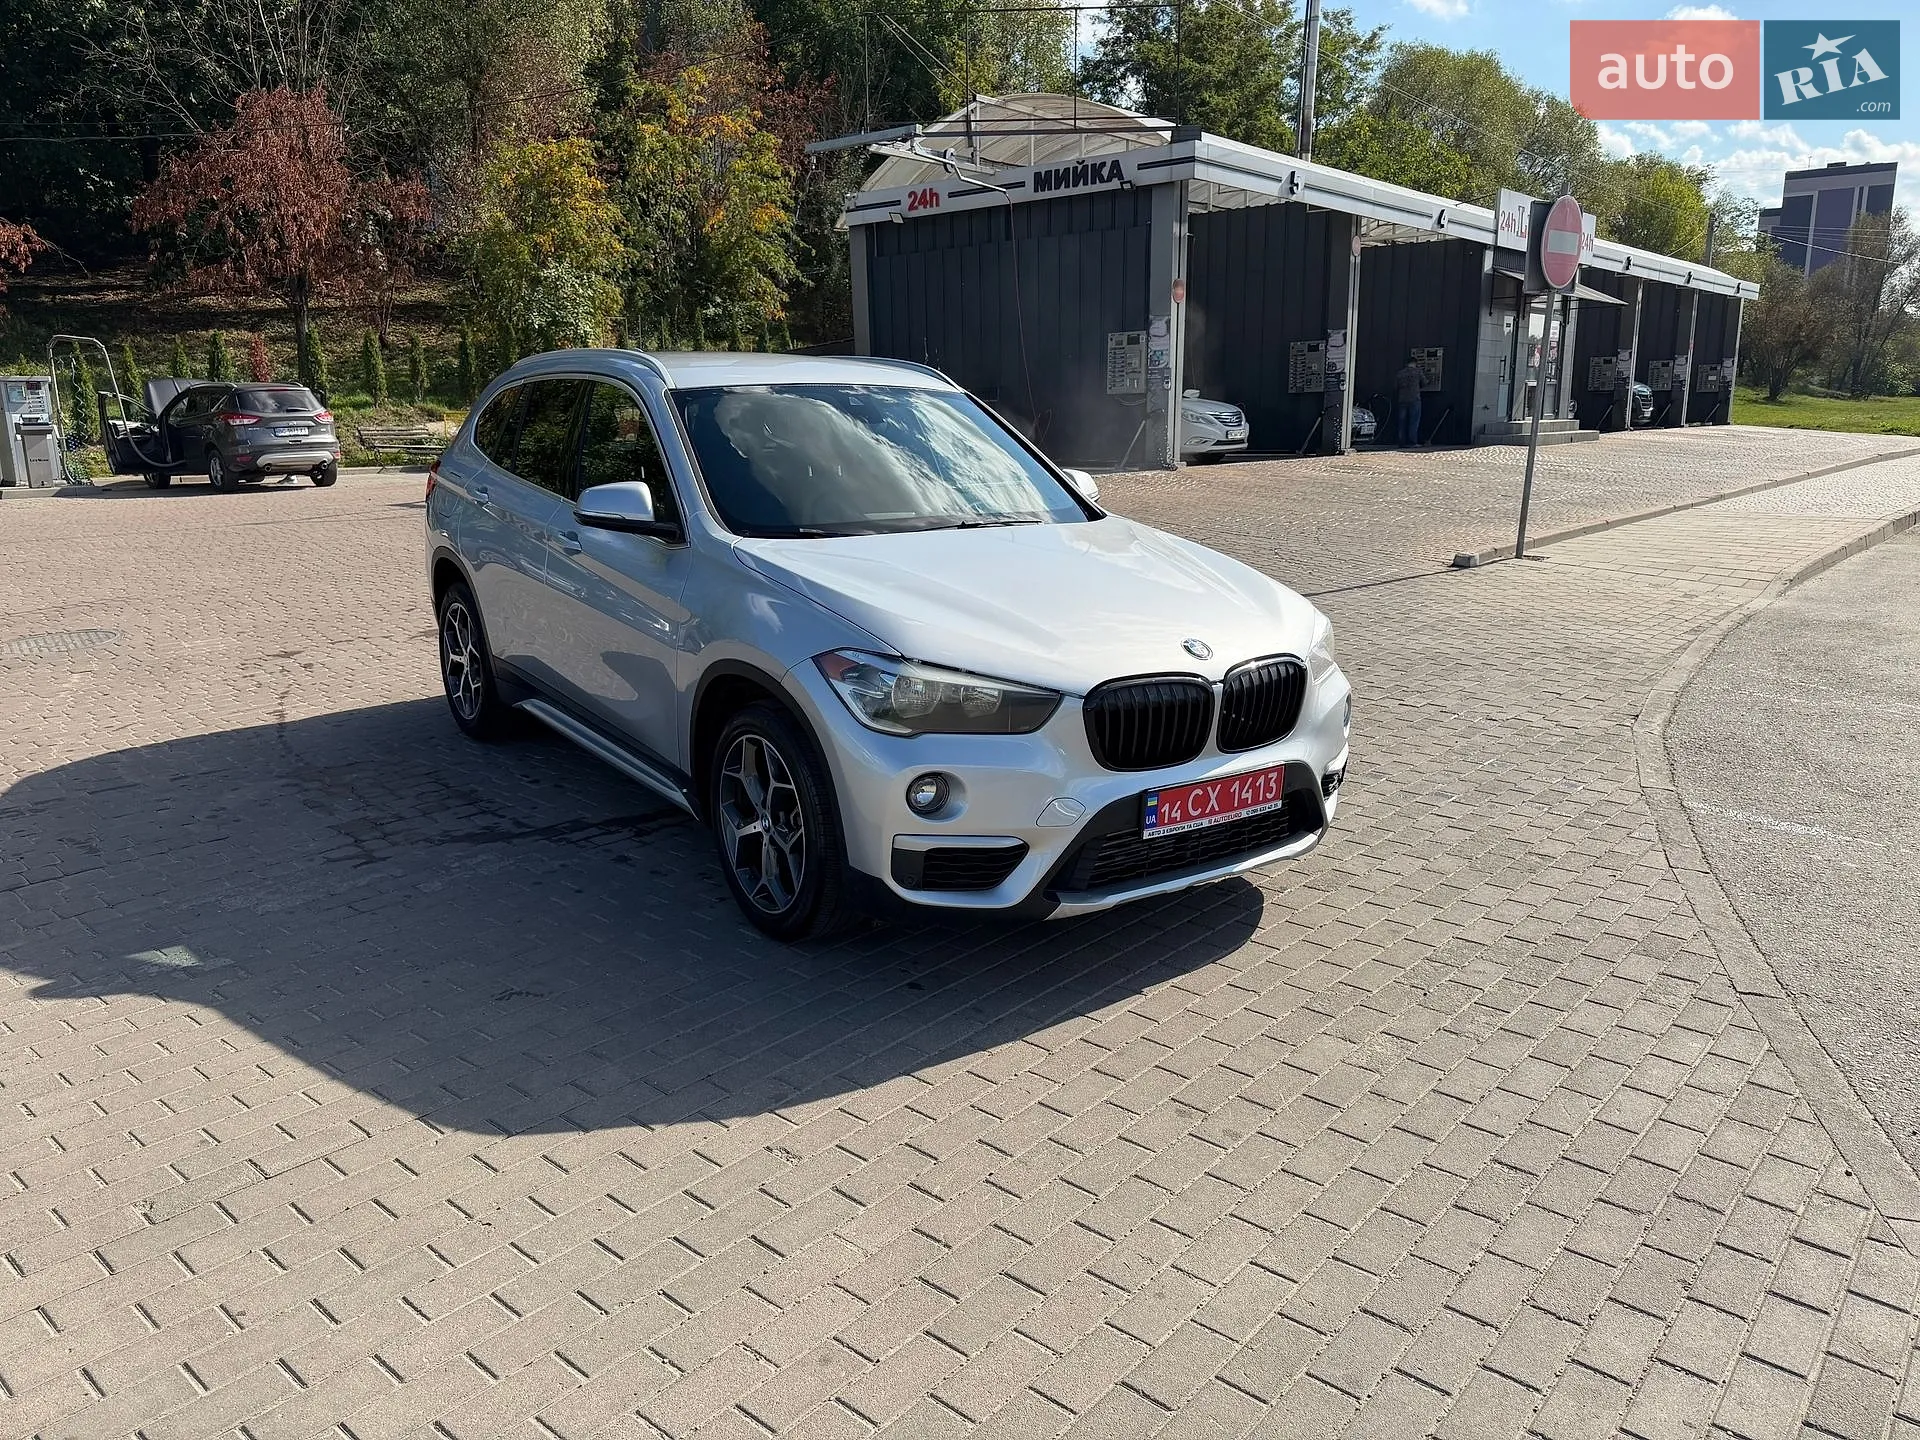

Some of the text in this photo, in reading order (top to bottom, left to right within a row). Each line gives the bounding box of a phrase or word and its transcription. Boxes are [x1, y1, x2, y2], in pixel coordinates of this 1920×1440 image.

[1033, 159, 1124, 193] МИЙКА
[907, 187, 940, 212] 24h
[1500, 210, 1516, 234] 24h
[1161, 800, 1182, 824] 14
[1230, 772, 1278, 808] 1413
[1145, 814, 1156, 825] UA
